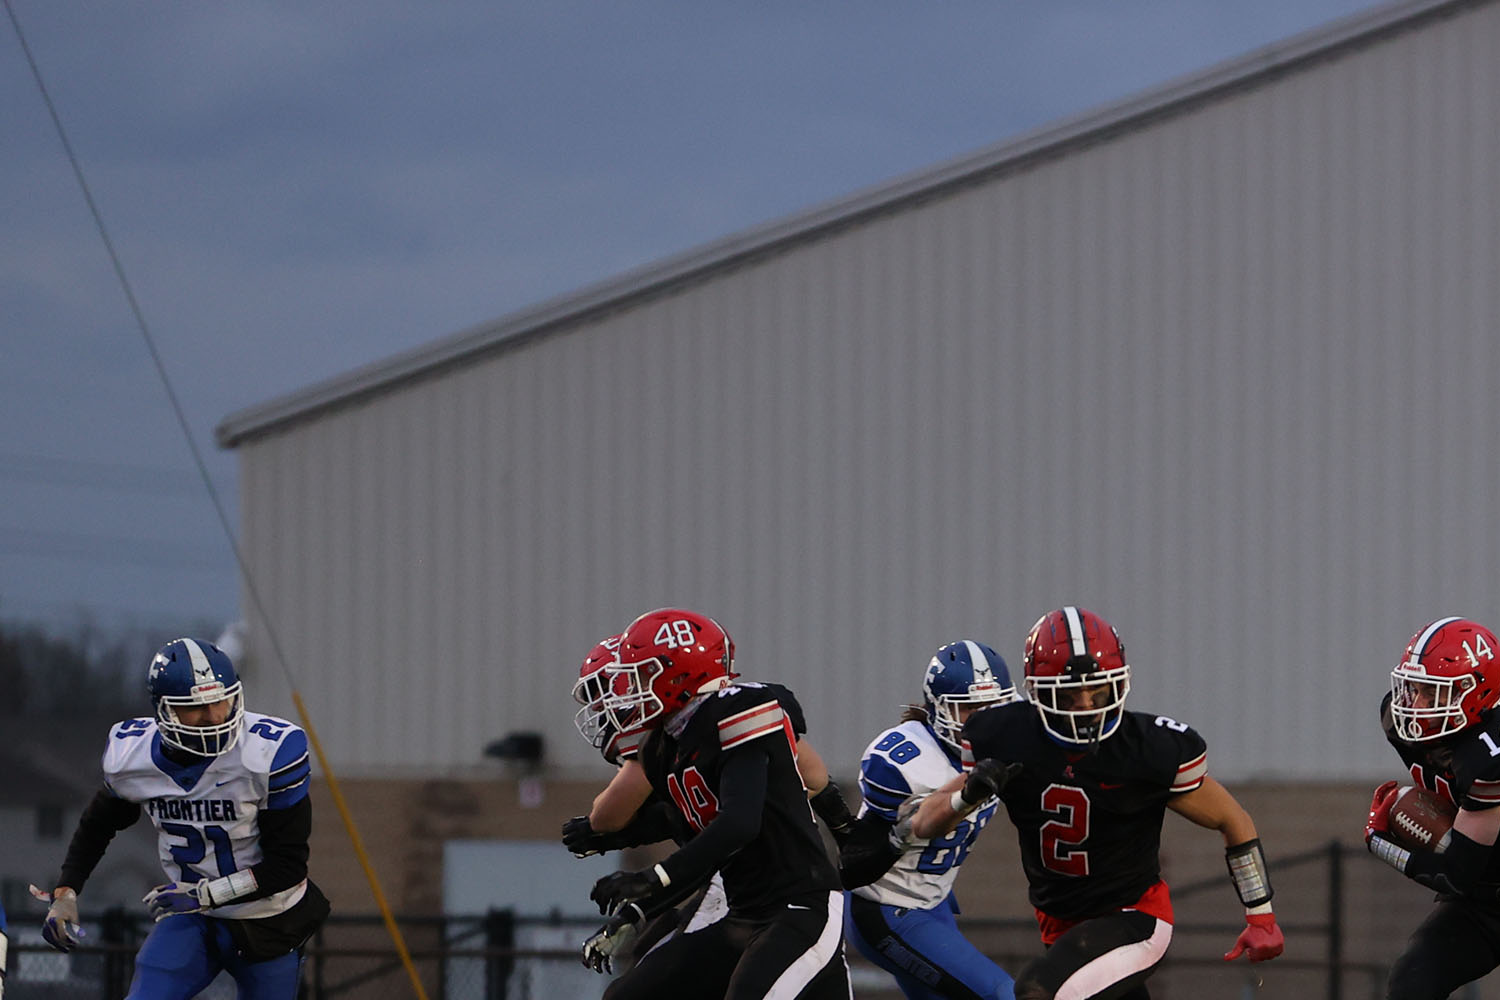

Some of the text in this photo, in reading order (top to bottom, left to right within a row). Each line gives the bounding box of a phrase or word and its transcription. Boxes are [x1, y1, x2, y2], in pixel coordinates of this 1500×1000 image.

[653, 619, 696, 649] 48
[1461, 633, 1495, 668] 14
[248, 717, 292, 741] 21
[1154, 715, 1189, 733] 2
[875, 731, 921, 765] 88
[150, 798, 238, 821] FRONTIER
[1039, 782, 1091, 877] 2
[160, 822, 238, 883] 21
